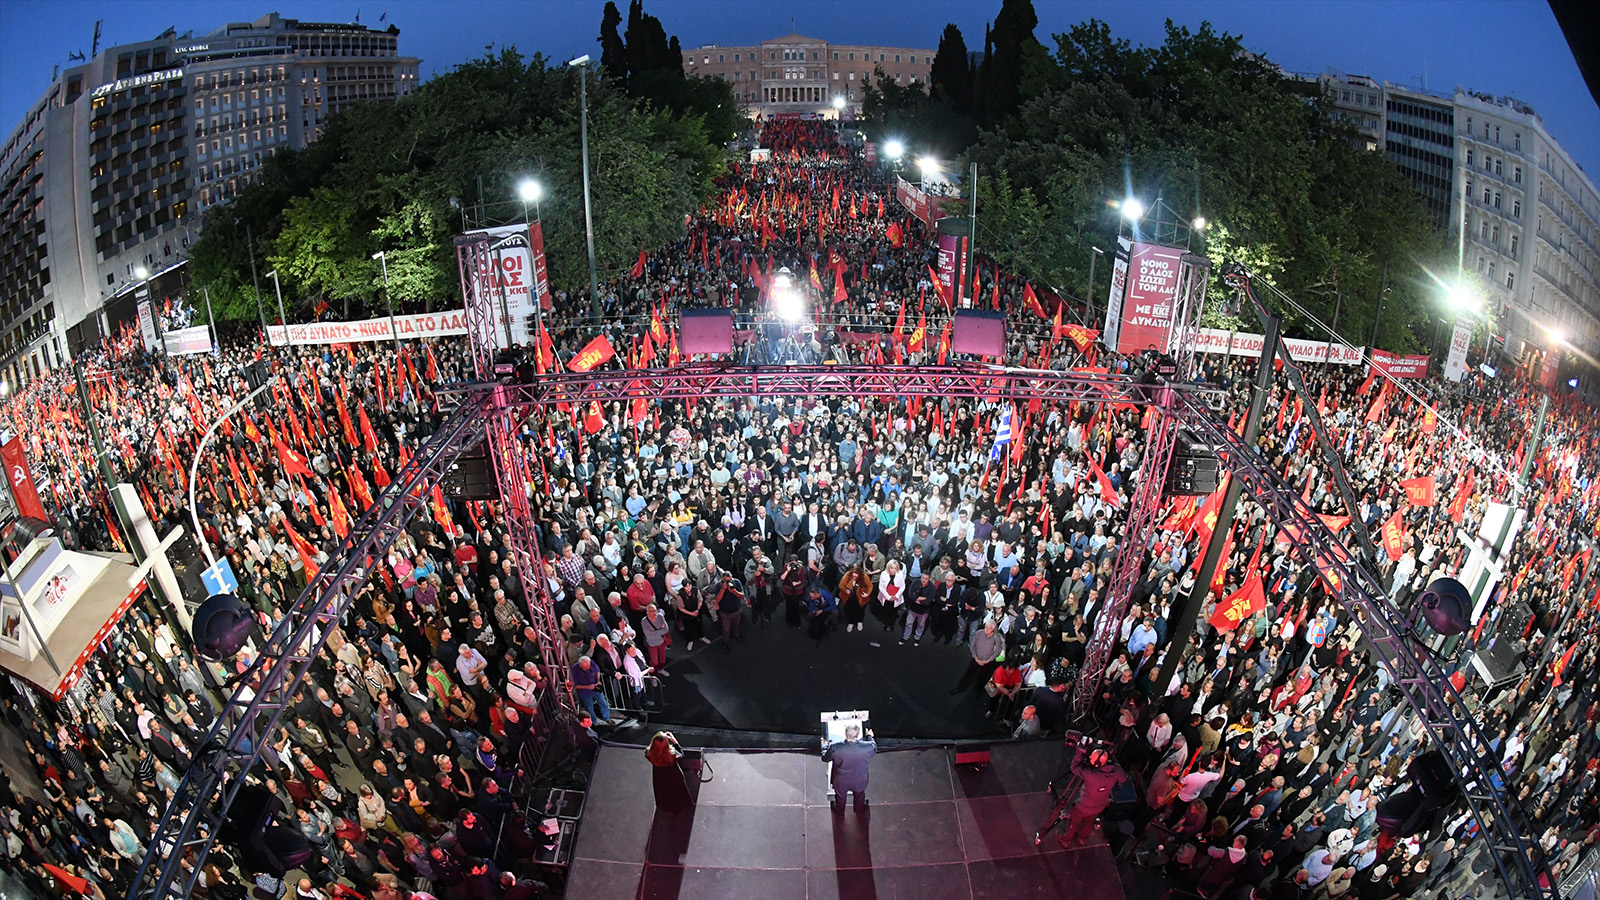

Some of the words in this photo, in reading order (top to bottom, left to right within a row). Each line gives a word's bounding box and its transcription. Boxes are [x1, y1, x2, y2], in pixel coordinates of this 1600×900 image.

[115, 74, 152, 90] ATHENS
[153, 68, 183, 82] PLAZA
[1141, 259, 1169, 270] ΜΟΝΟ
[1140, 267, 1148, 275] Ο
[1149, 267, 1174, 278] ΛΑΟΣ
[1139, 274, 1167, 286] ΣΩΖΕΙ
[1138, 282, 1158, 293] ΤΟΝ
[1135, 304, 1151, 315] ΜΕ
[1152, 306, 1170, 316] ΚΚΕ
[1130, 316, 1170, 328] ΔΥΝΑΤΟ
[310, 327, 350, 341] ΔΥΝΑΤΟ
[359, 321, 390, 337] ΝΙΚΗ
[416, 317, 436, 332] ΤΟ
